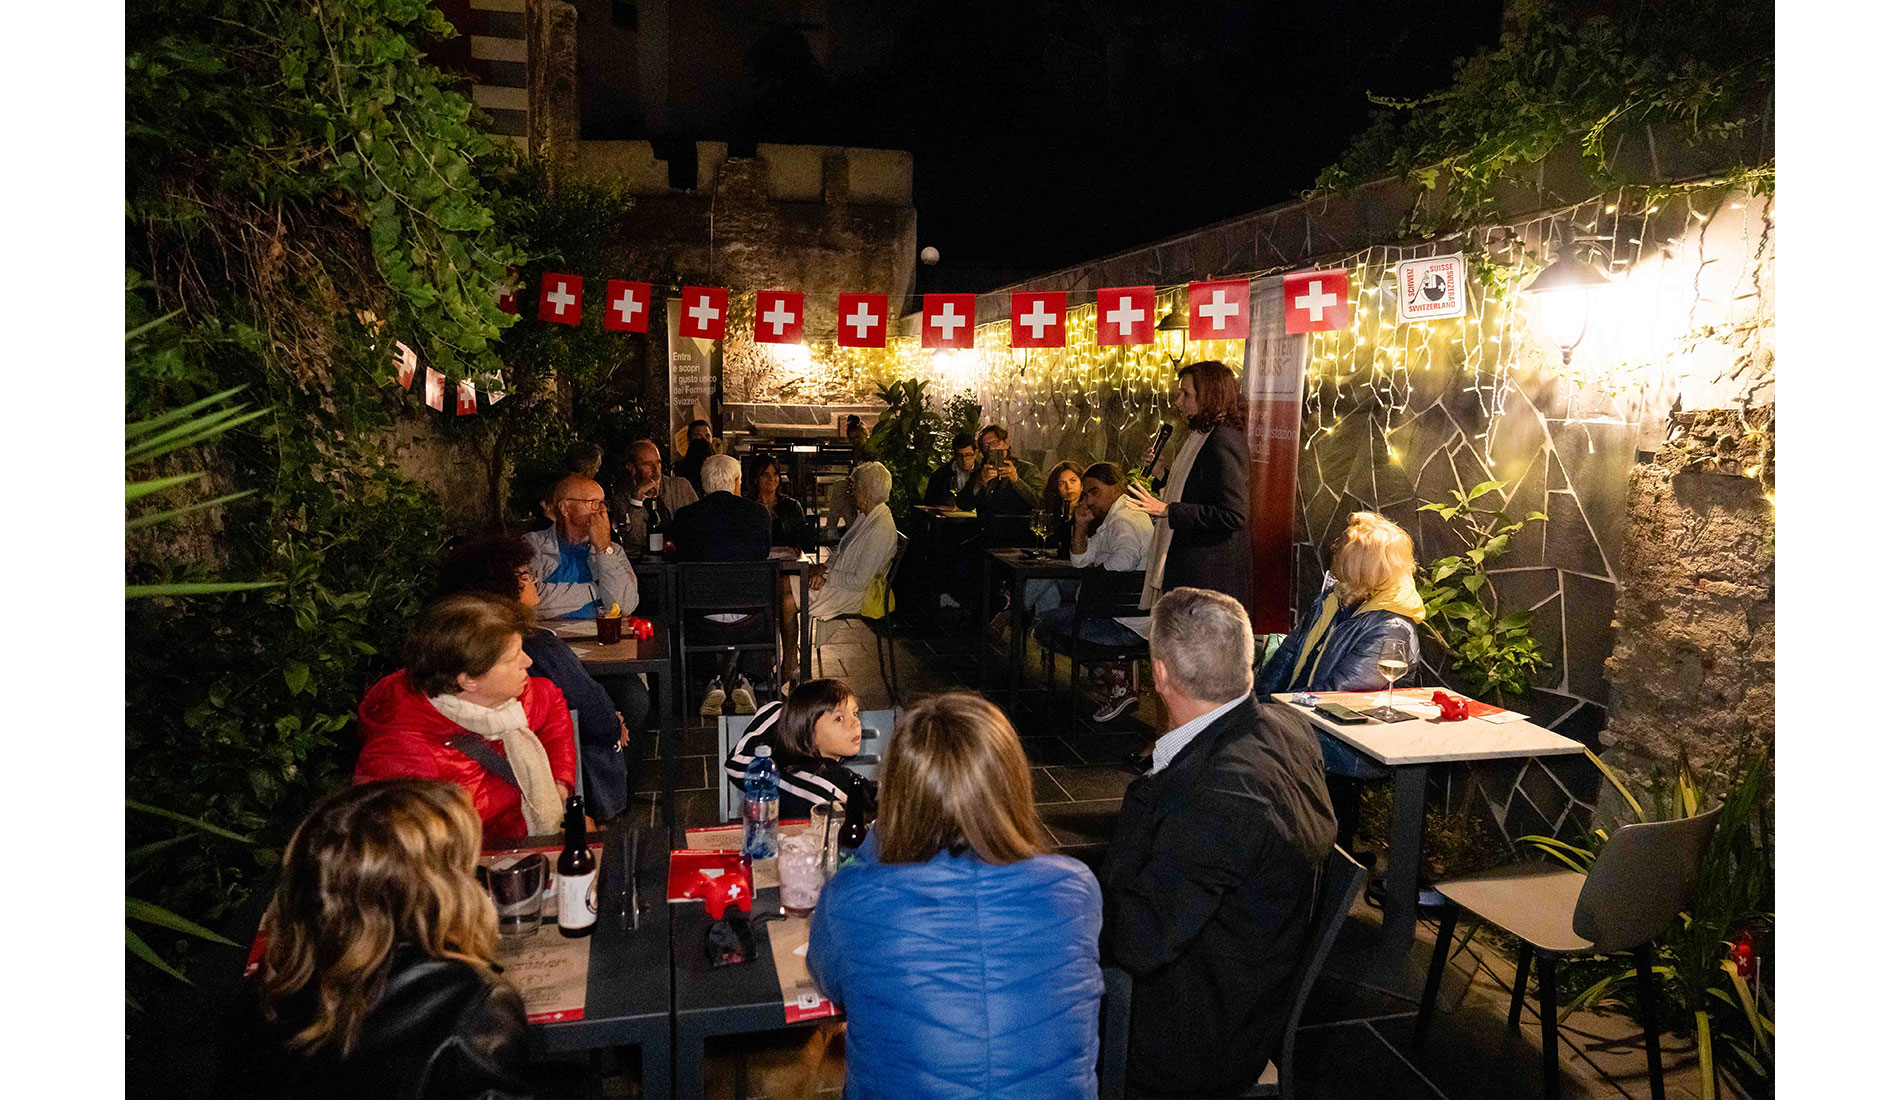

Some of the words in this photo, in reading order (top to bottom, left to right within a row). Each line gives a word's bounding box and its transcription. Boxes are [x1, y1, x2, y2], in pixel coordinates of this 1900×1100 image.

[1430, 264, 1453, 272] SUISSE
[1407, 268, 1415, 297] SCHWEIZ
[1447, 271, 1455, 301] SVIZZERA
[1408, 302, 1456, 312] SWITZERLAND
[673, 352, 691, 361] Entra
[679, 364, 700, 373] scopri
[678, 375, 698, 385] gusto
